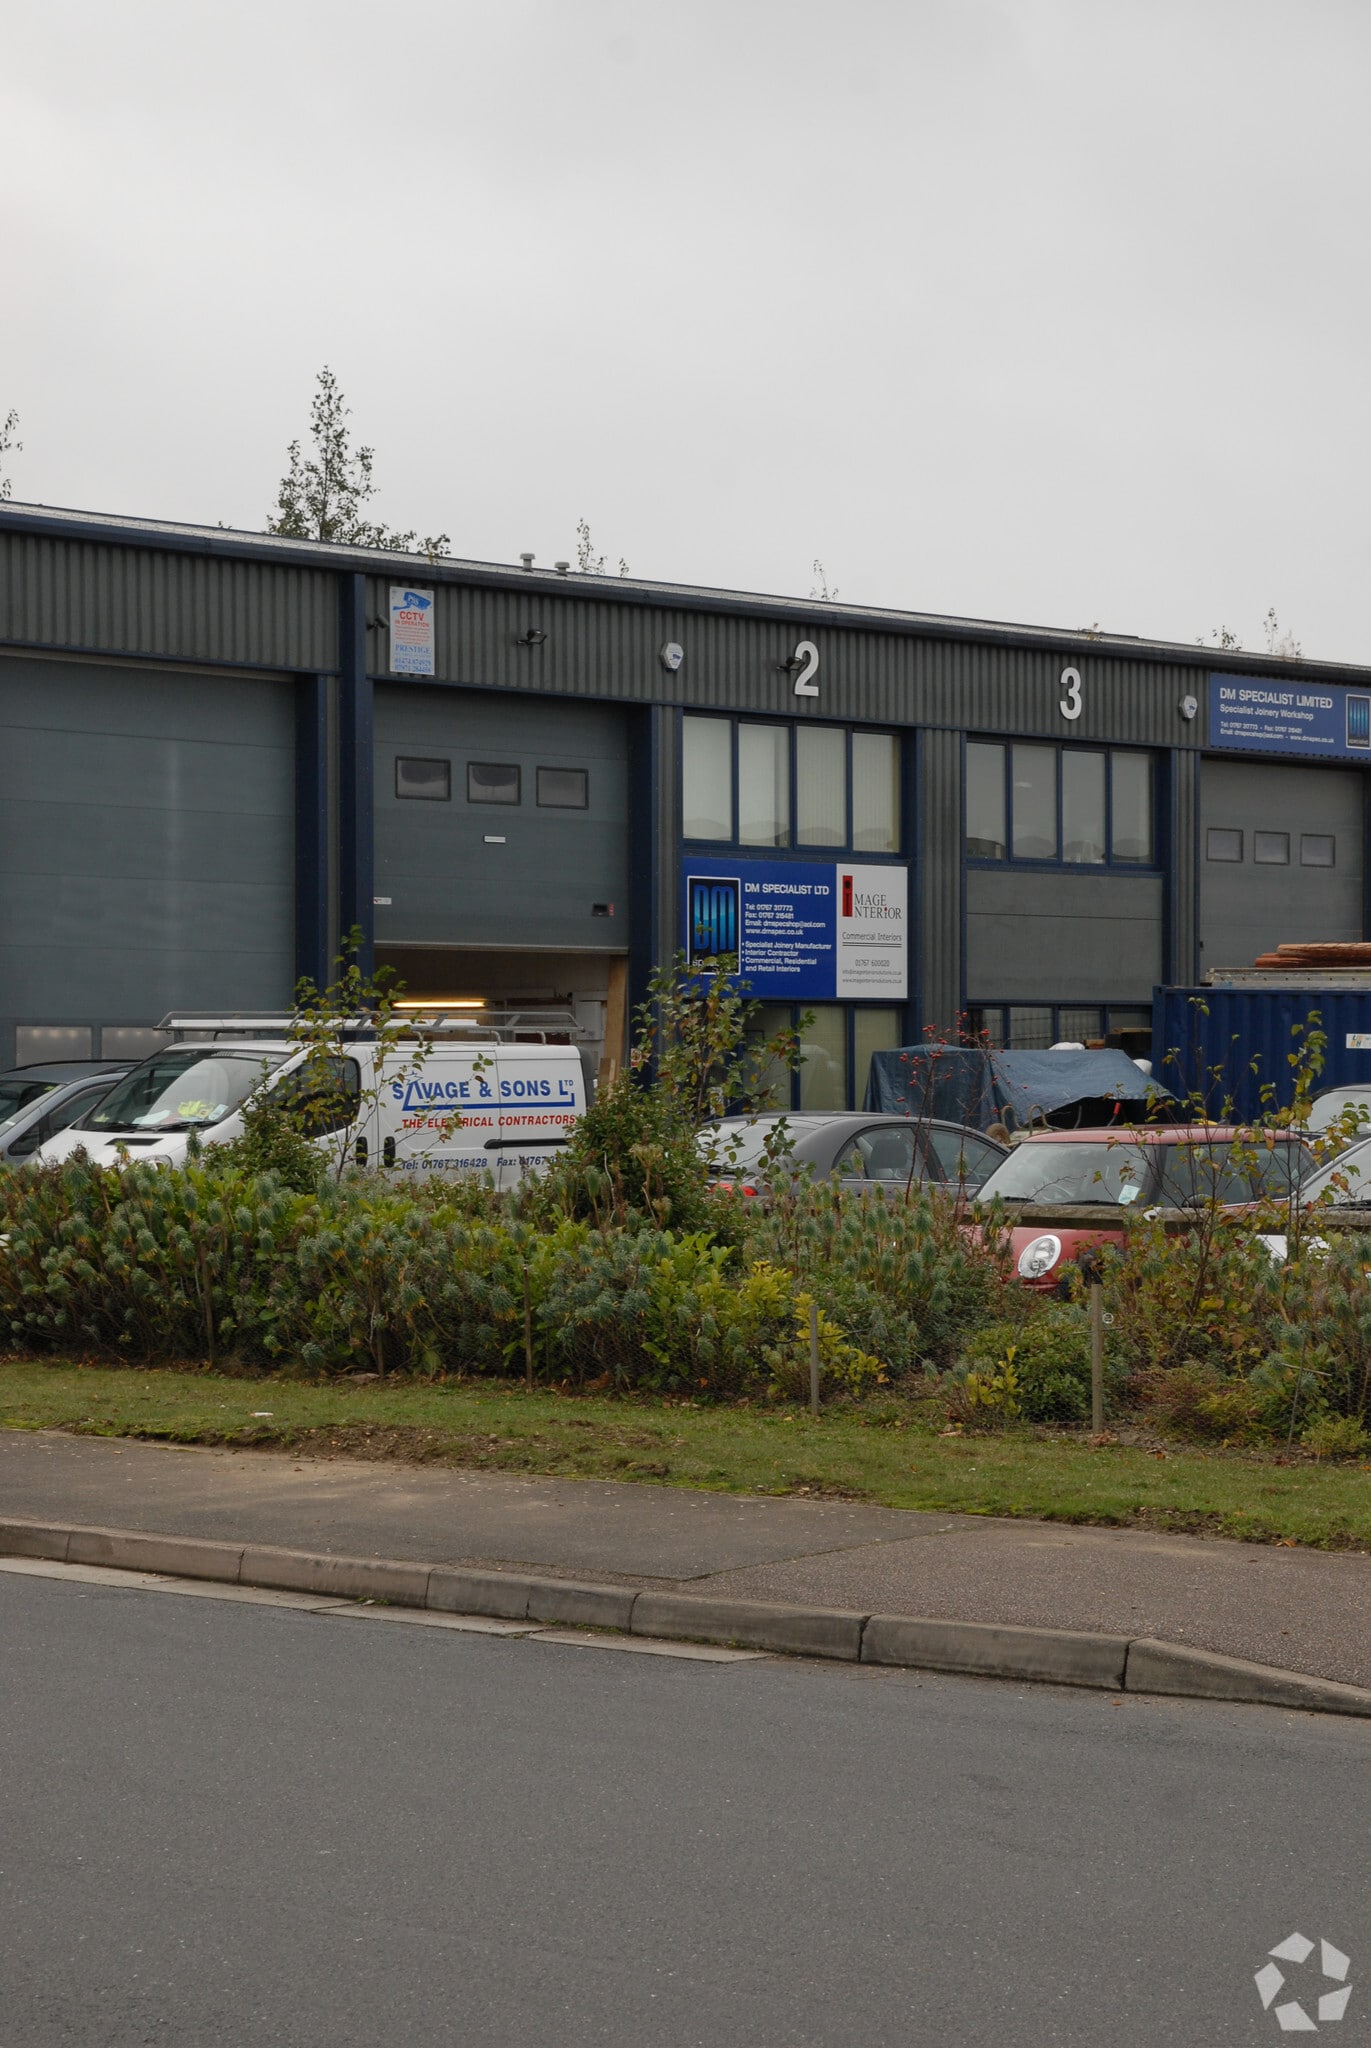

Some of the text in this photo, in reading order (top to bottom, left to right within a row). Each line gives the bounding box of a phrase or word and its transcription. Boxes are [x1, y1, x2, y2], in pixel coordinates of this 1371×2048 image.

[399, 611, 424, 621] CCTV
[395, 644, 431, 654] PRESTIGE
[794, 640, 820, 697] 2
[1059, 667, 1082, 720] 3
[1220, 687, 1333, 709] DM SPECIALIST LIMITED
[1219, 704, 1314, 721] Specialist Joinery Workshop
[745, 883, 830, 895] DM SPECIALIST LTD
[763, 920, 826, 928] dmspecshop@aol.com
[745, 928, 804, 936] www.dmspec.co.uk
[842, 931, 902, 942] Commercial Interiors
[745, 941, 832, 950] Specialist Joinery Manufacturer
[767, 949, 799, 957] Contractor
[745, 957, 817, 965] Commercial, Residential
[855, 959, 869, 967] 01767
[392, 1080, 471, 1101] SAVAGE
[479, 1081, 493, 1098] &
[501, 1079, 551, 1097] SONS
[402, 1114, 575, 1129] THE ELERICAL CONTRACTORS
[401, 1159, 418, 1170] Tel:
[421, 1158, 449, 1170] 01767
[453, 1157, 488, 1168] 316428
[496, 1156, 517, 1167] Fax:
